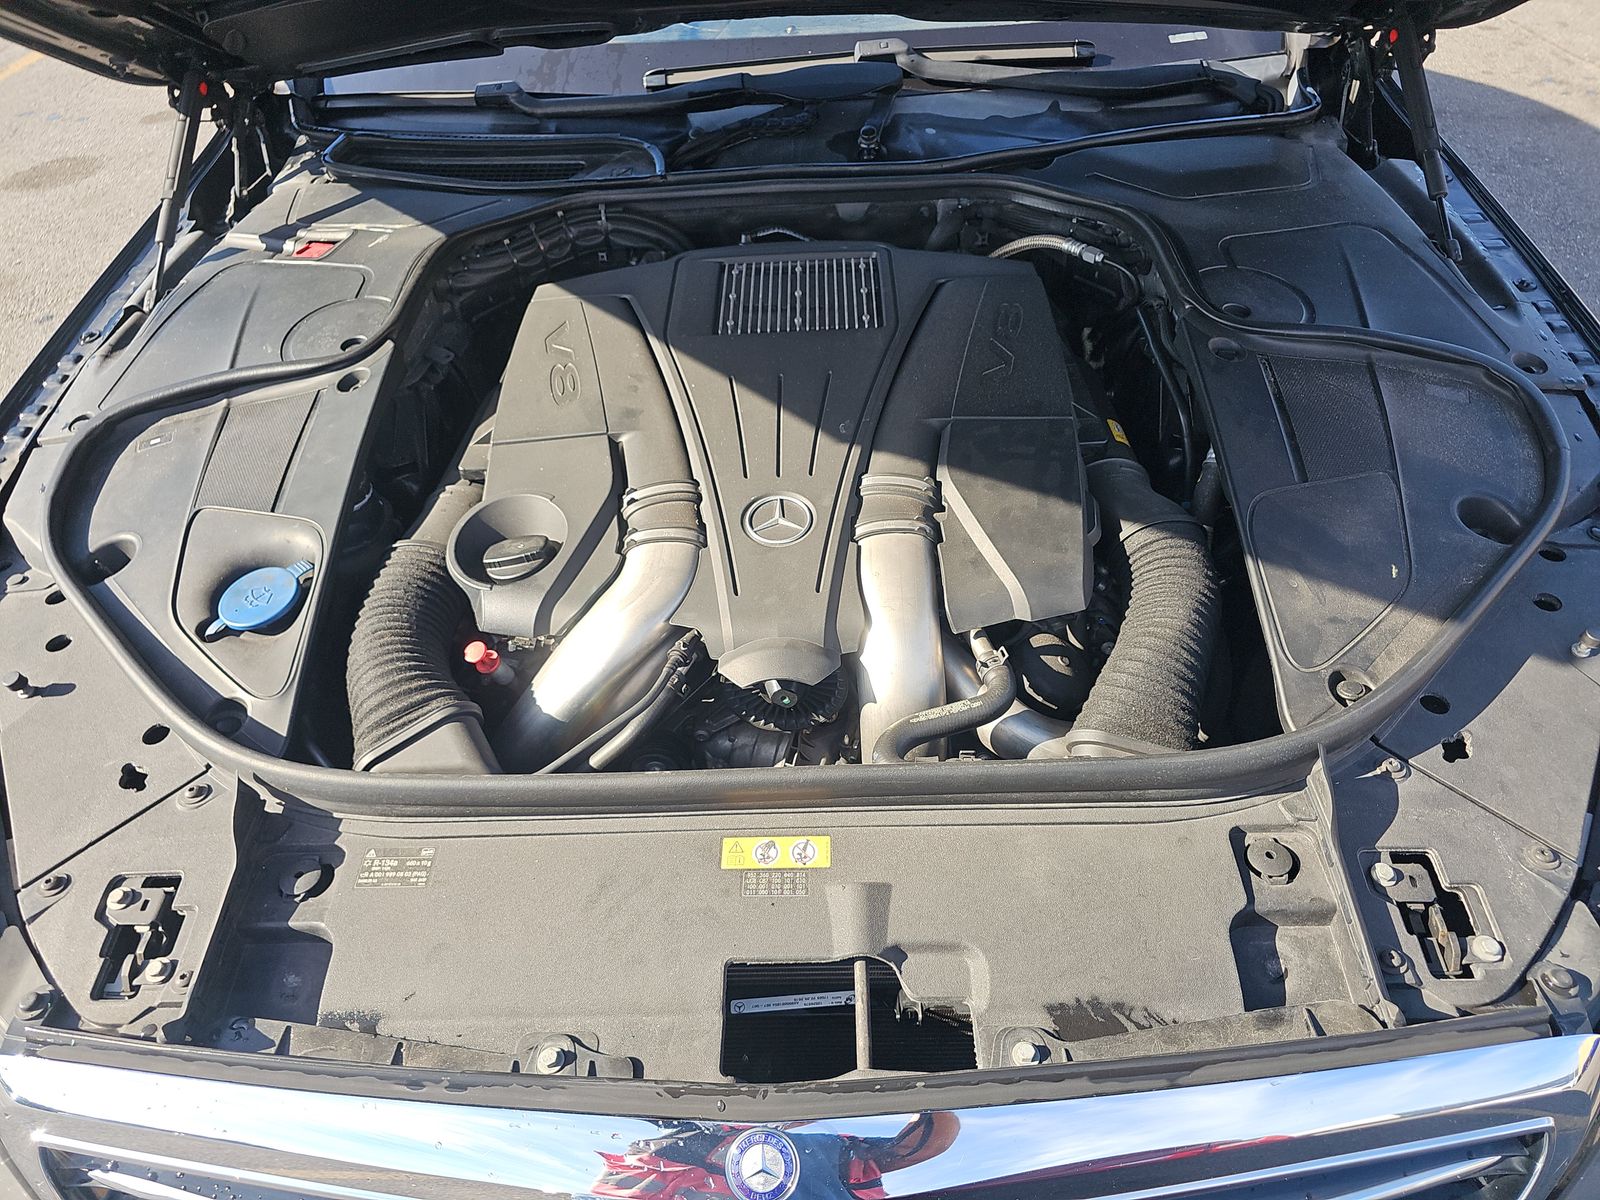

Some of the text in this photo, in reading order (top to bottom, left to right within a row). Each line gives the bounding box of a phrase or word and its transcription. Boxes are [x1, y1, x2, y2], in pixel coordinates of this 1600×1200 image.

[544, 319, 581, 406] V8
[982, 303, 1024, 376] V8
[739, 1134, 783, 1151] MERCEDES
